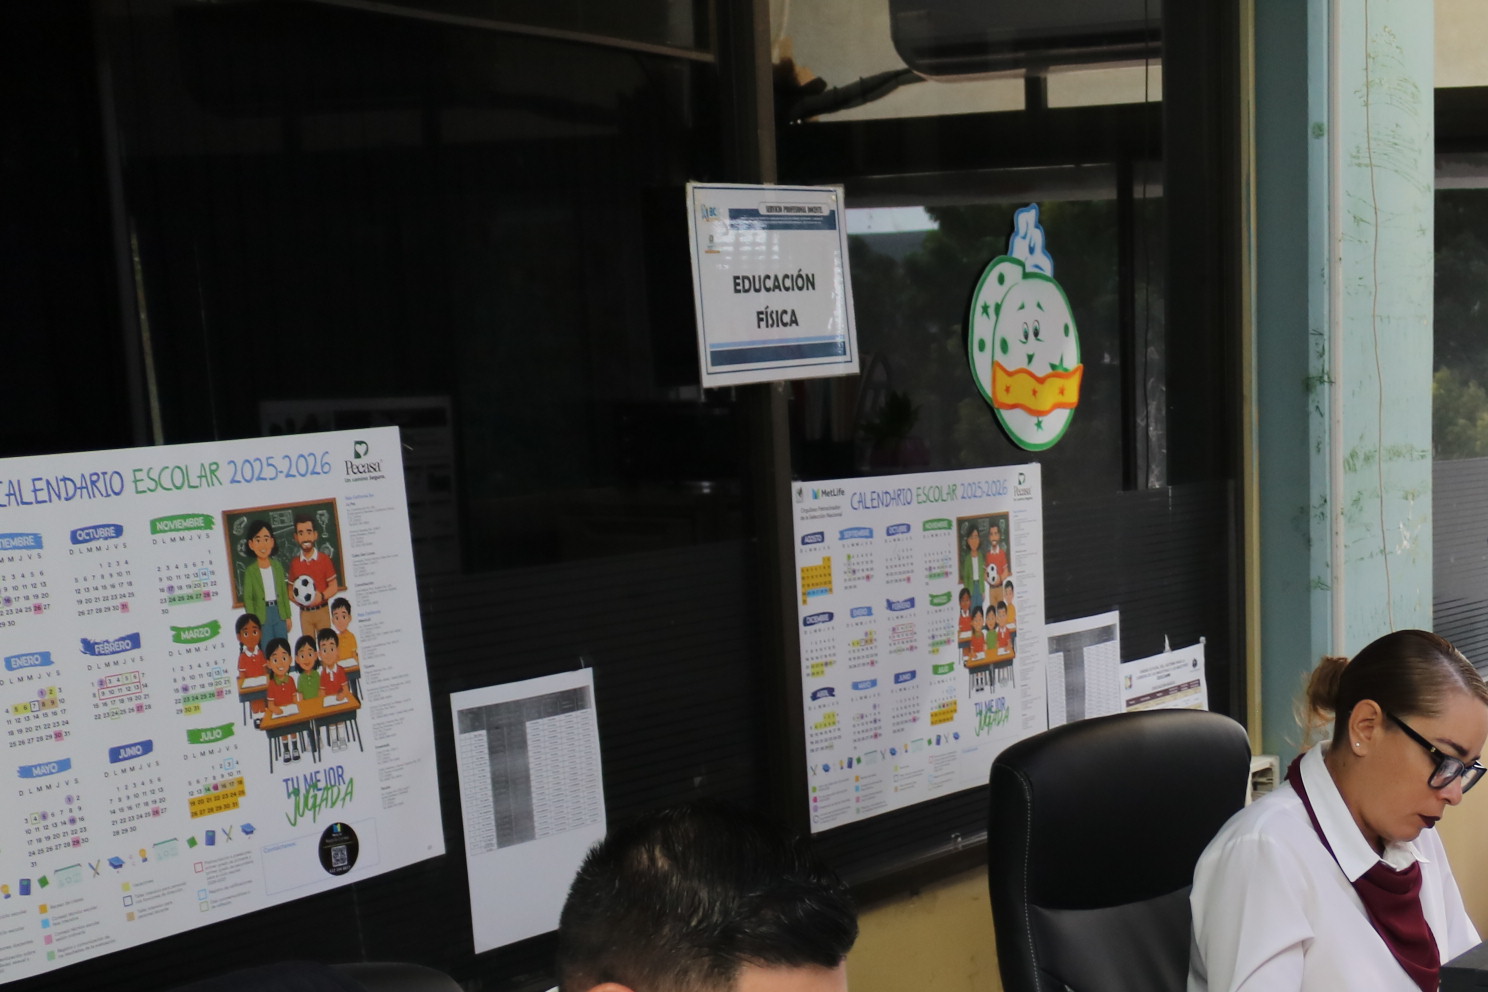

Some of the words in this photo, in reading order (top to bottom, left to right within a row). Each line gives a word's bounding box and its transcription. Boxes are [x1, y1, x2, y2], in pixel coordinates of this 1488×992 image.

[733, 268, 816, 294] EDUCACIÓN
[756, 305, 799, 329] FÍSICA
[132, 461, 223, 495] ESCOLAR
[227, 451, 332, 485] 2025-2026
[344, 459, 382, 476] Pecasa
[821, 488, 845, 498] MetLife
[850, 488, 913, 511] CALENDARIO
[916, 483, 958, 505] ESCOLAR
[960, 478, 1009, 500] 2025-2026
[156, 516, 205, 531] NOVIEMBRE
[76, 526, 116, 541] OCTUBRE
[0, 535, 35, 548] IEMBRE
[181, 627, 211, 640] MARZO
[94, 640, 132, 655] FEBRERO
[10, 655, 41, 668] ENERO
[199, 729, 223, 742] JULIO
[118, 745, 143, 759] JUNIO
[31, 762, 59, 777] MAYO
[282, 775, 300, 799] TU
[303, 765, 346, 794] MEJOR
[285, 777, 354, 827] JUGADA
